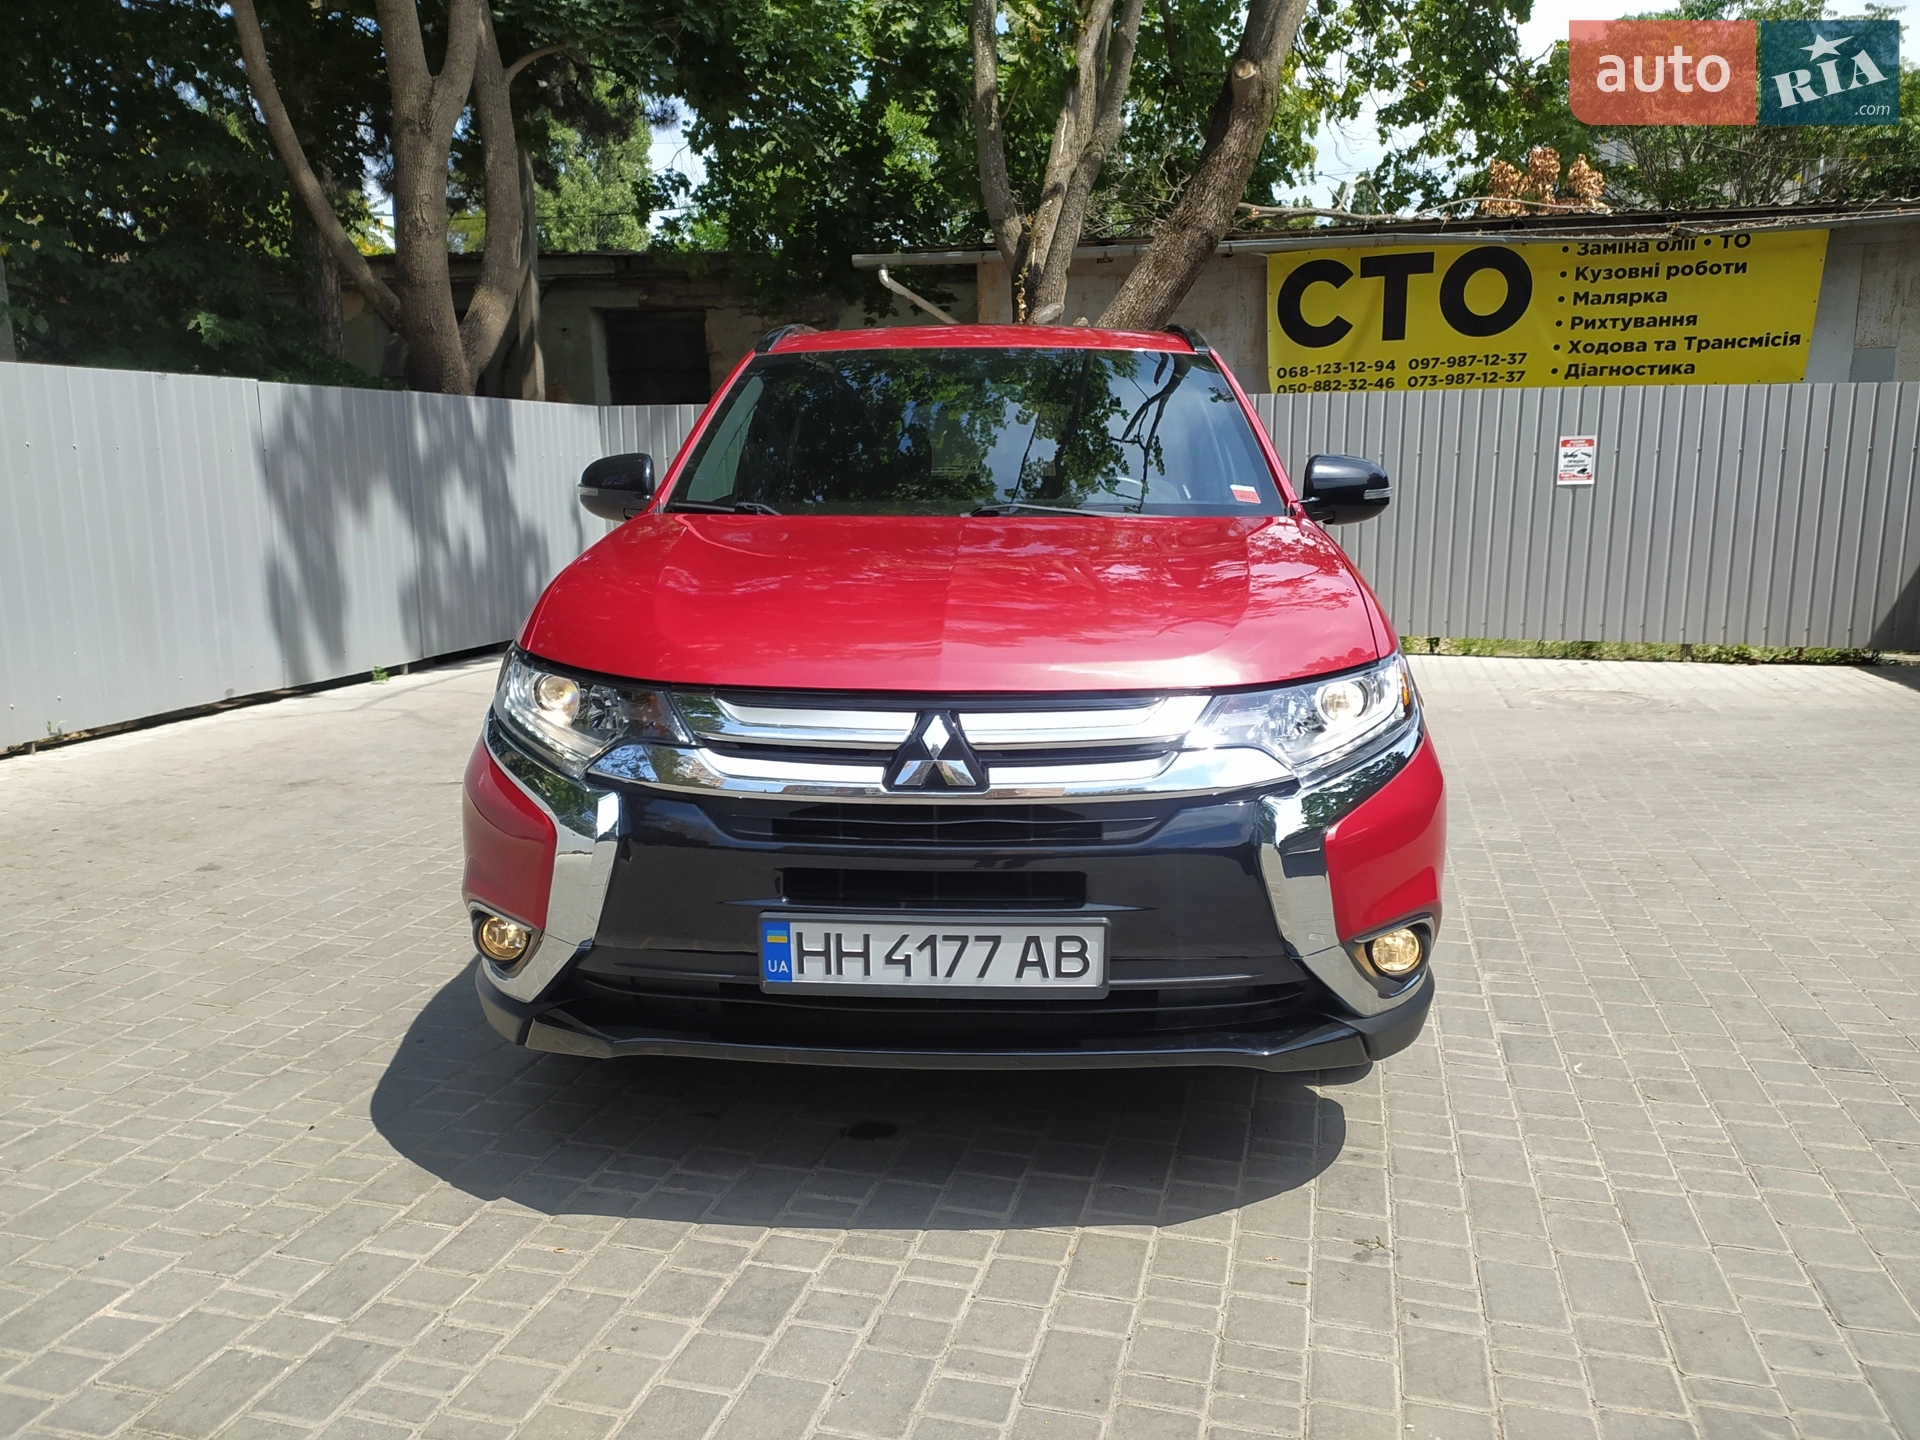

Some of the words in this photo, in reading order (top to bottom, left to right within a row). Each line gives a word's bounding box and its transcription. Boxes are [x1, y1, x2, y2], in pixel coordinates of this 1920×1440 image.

[1576, 239, 1649, 257] Заміна
[1719, 233, 1752, 249] ТО
[1574, 263, 1660, 283] Кузовні
[1665, 260, 1748, 280] роботи
[1277, 245, 1533, 348] СТО
[1572, 289, 1668, 307] Малярка
[1570, 313, 1698, 332] Рихтування
[1567, 339, 1648, 356] Ходова
[1654, 340, 1677, 352] та
[1683, 332, 1801, 353] Трансмісія
[1276, 359, 1397, 380] 068-123-12-94
[1408, 352, 1528, 371] 097-987-12-37
[1564, 362, 1696, 380] Діагностика
[1276, 376, 1396, 394] 050-882-32-46
[1407, 370, 1527, 389] 073-987-12-37
[796, 932, 872, 977] HH
[884, 934, 1002, 979] 4177
[1015, 935, 1092, 979] AB
[767, 960, 789, 973] UA
